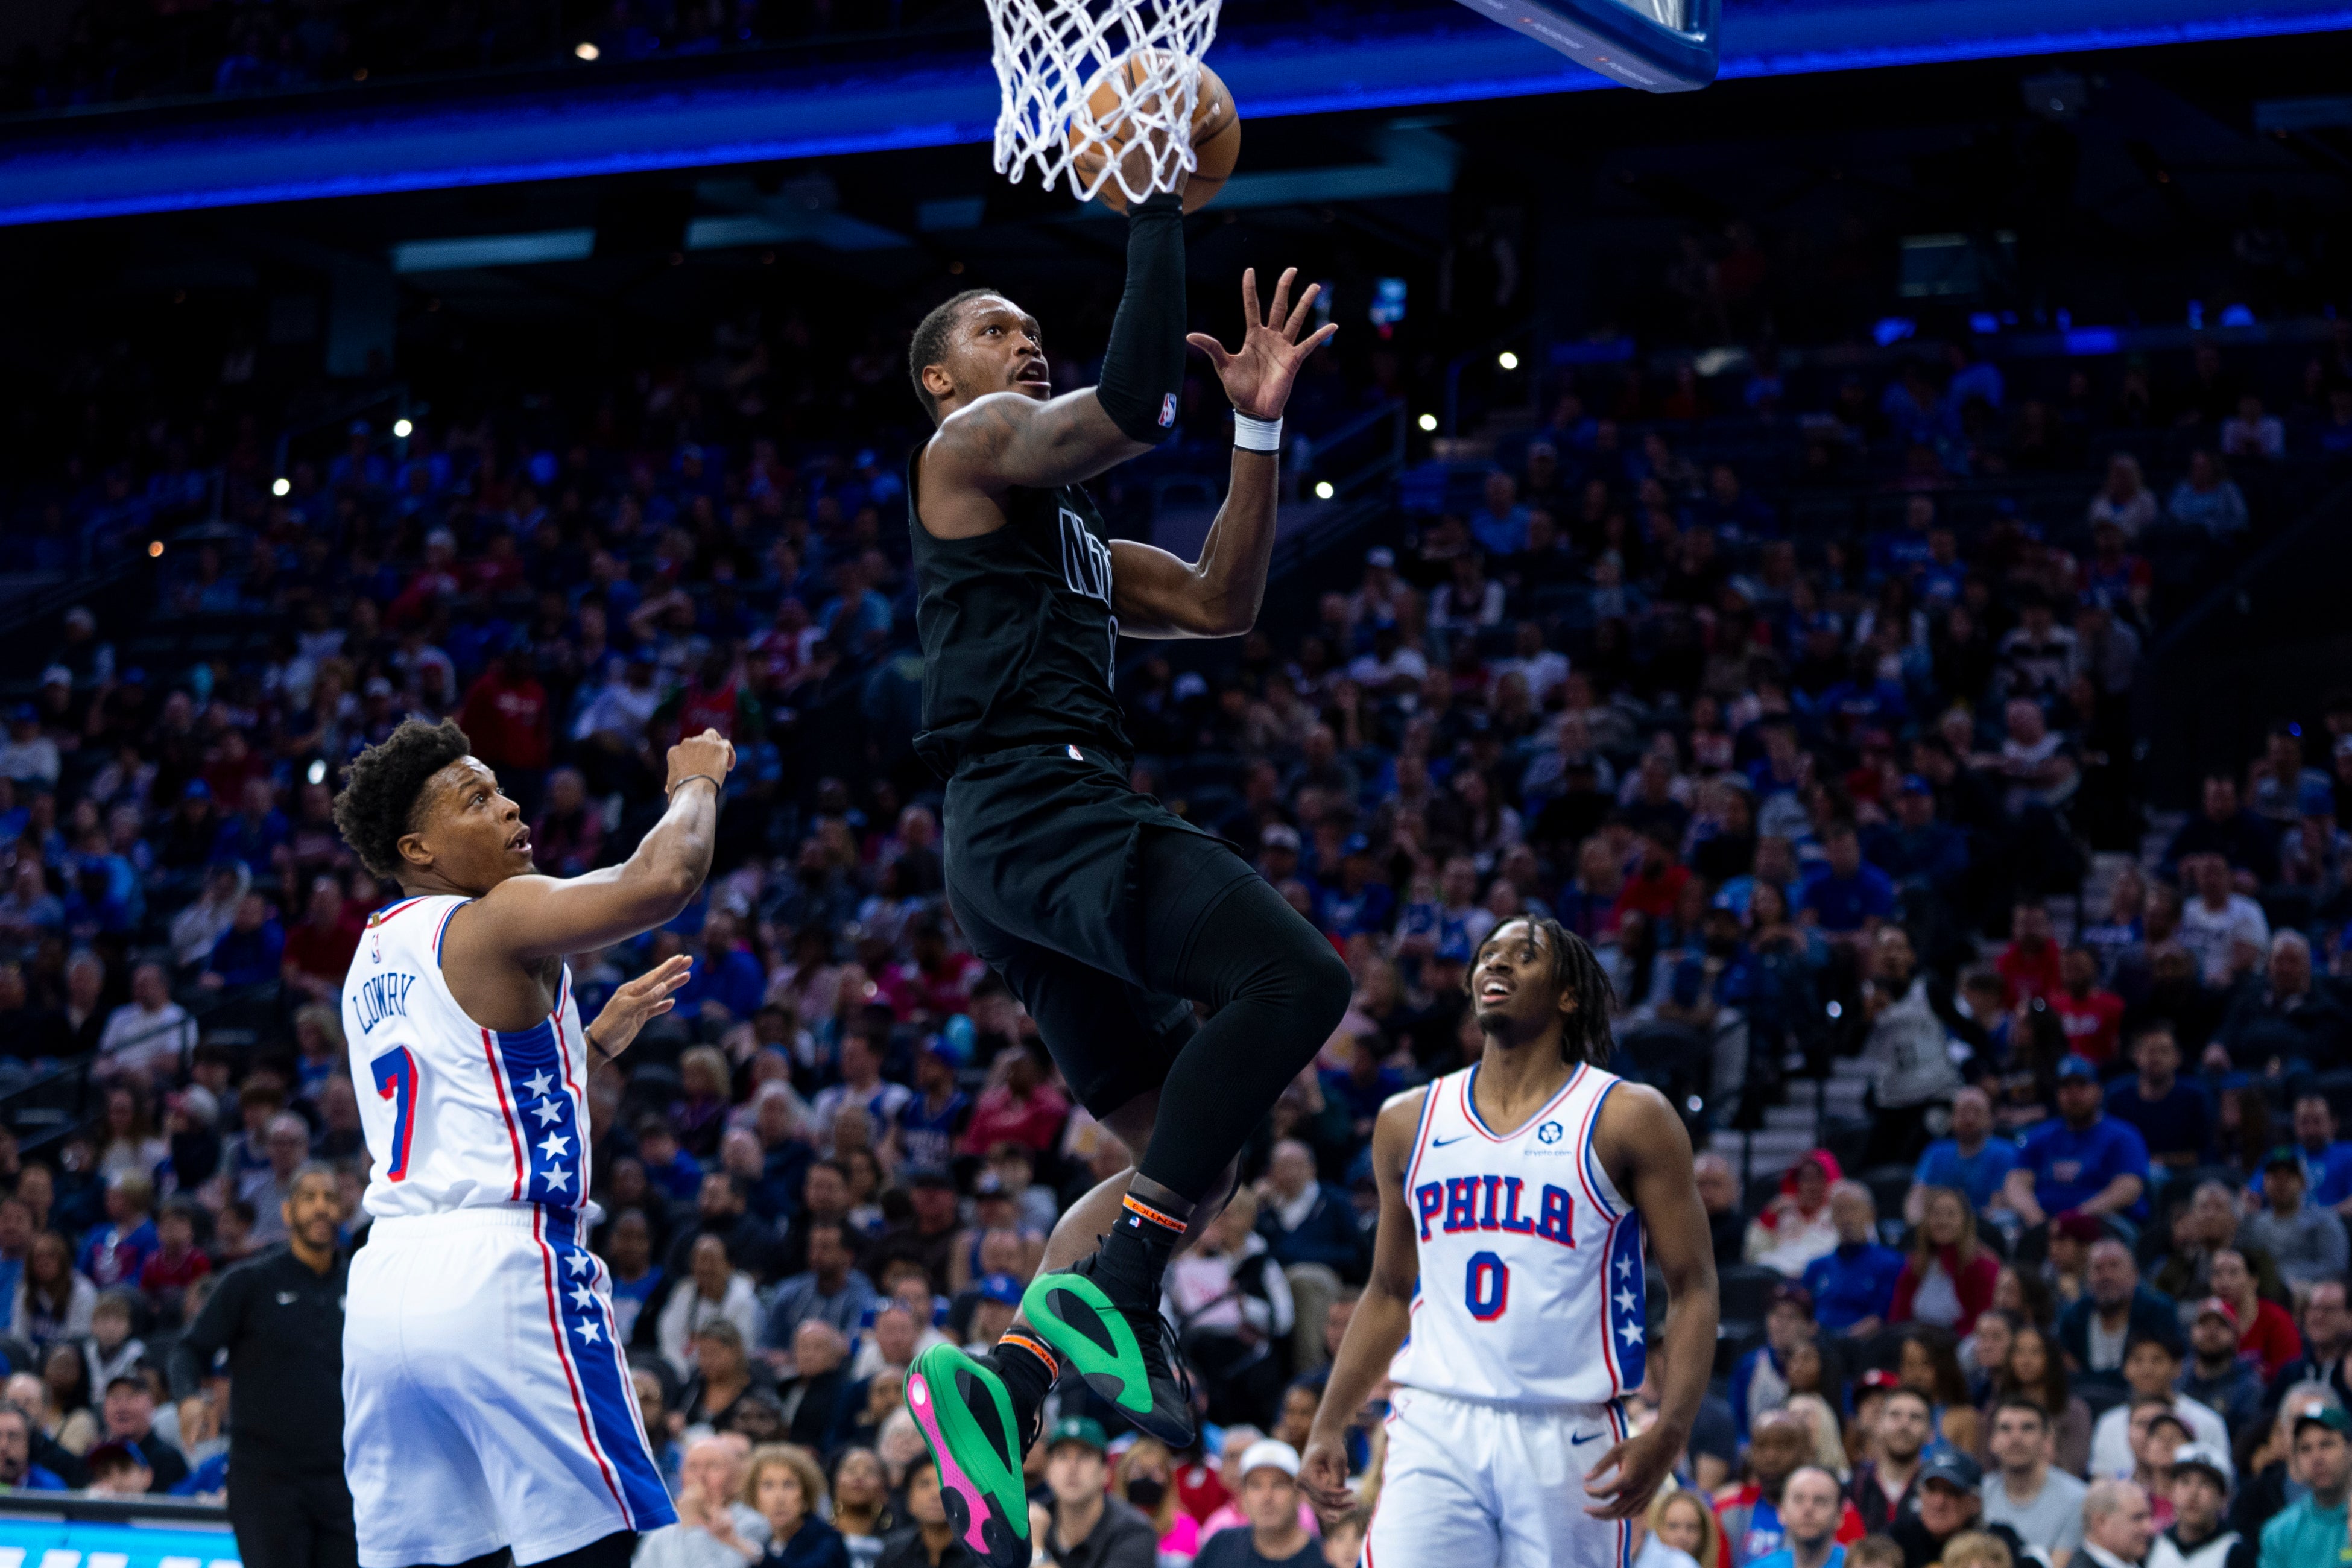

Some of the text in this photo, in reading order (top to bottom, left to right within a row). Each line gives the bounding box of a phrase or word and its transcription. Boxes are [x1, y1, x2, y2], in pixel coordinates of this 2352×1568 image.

[352, 972, 416, 1035] LOWRY
[370, 1044, 419, 1183] 7
[1415, 1174, 1576, 1250] PHILA
[1465, 1251, 1510, 1323] 0
